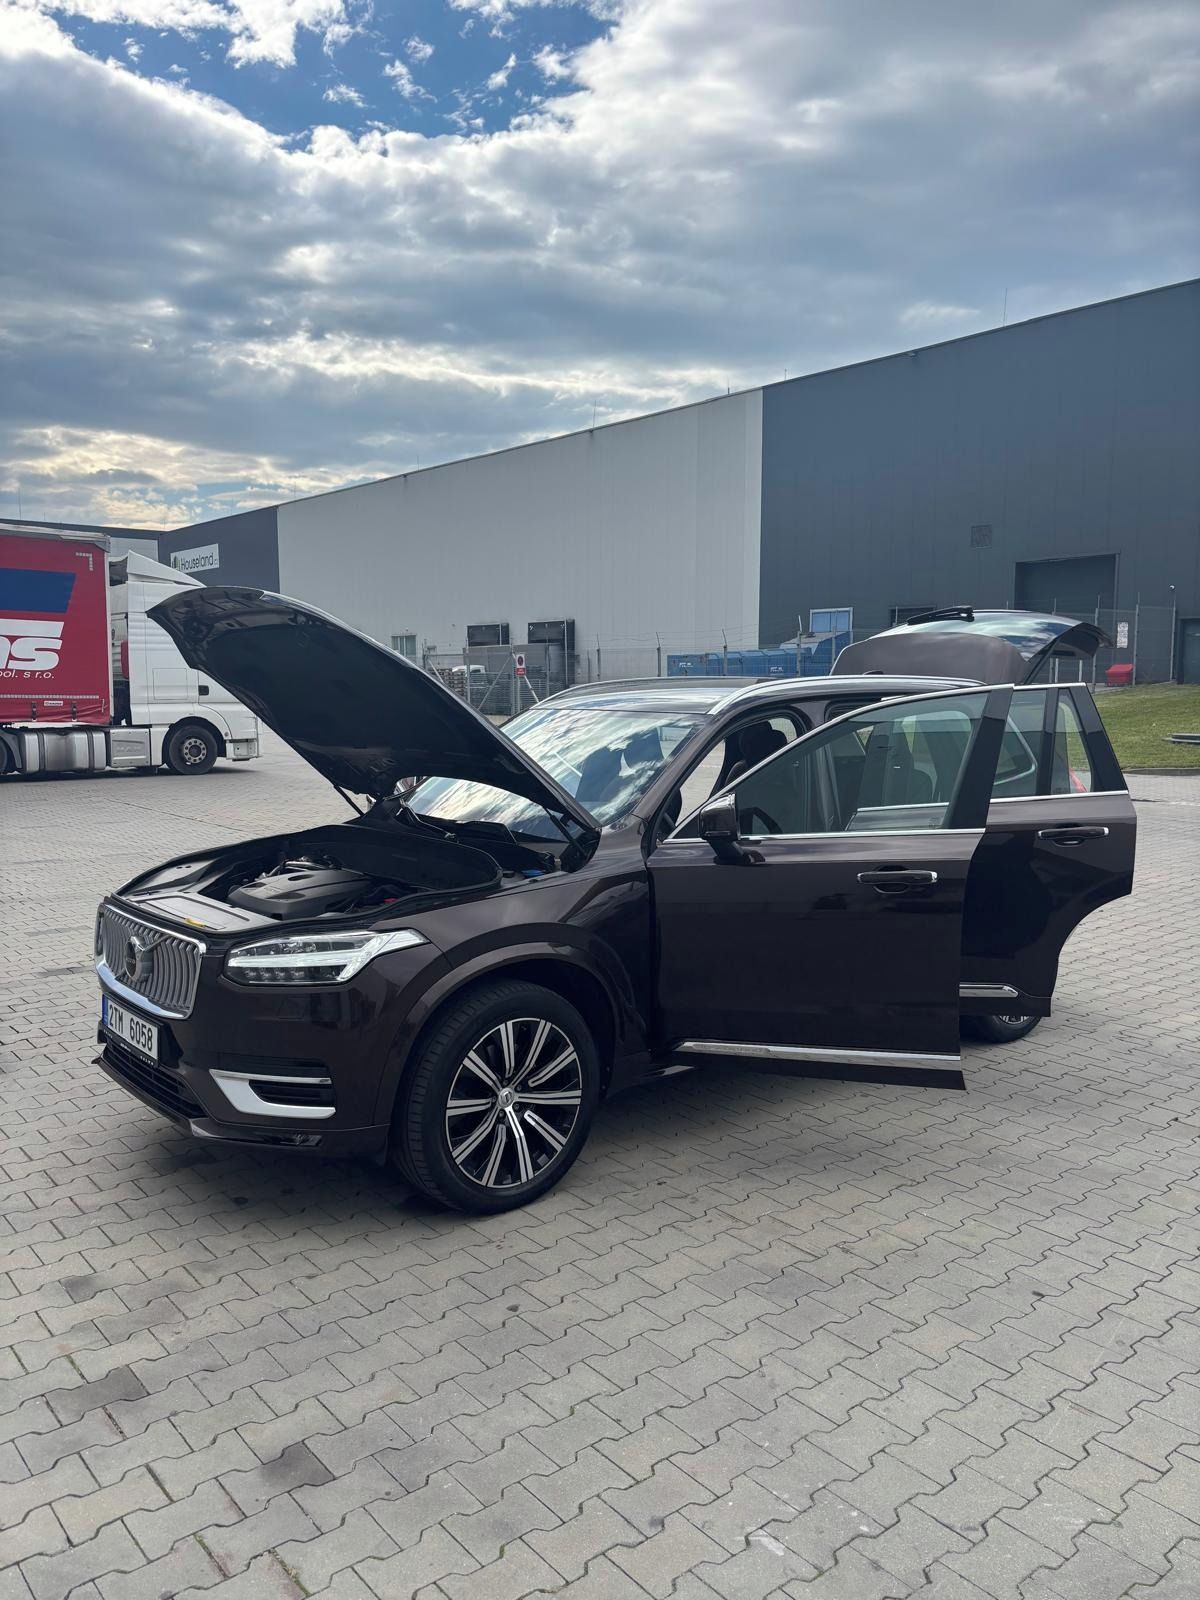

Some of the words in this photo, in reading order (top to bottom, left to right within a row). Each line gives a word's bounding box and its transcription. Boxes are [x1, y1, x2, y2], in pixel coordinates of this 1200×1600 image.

[0, 669, 18, 678] ol.
[23, 671, 31, 679] s
[35, 671, 55, 679] r.o.
[109, 1004, 123, 1034] 2TM
[129, 1017, 153, 1052] 6058
